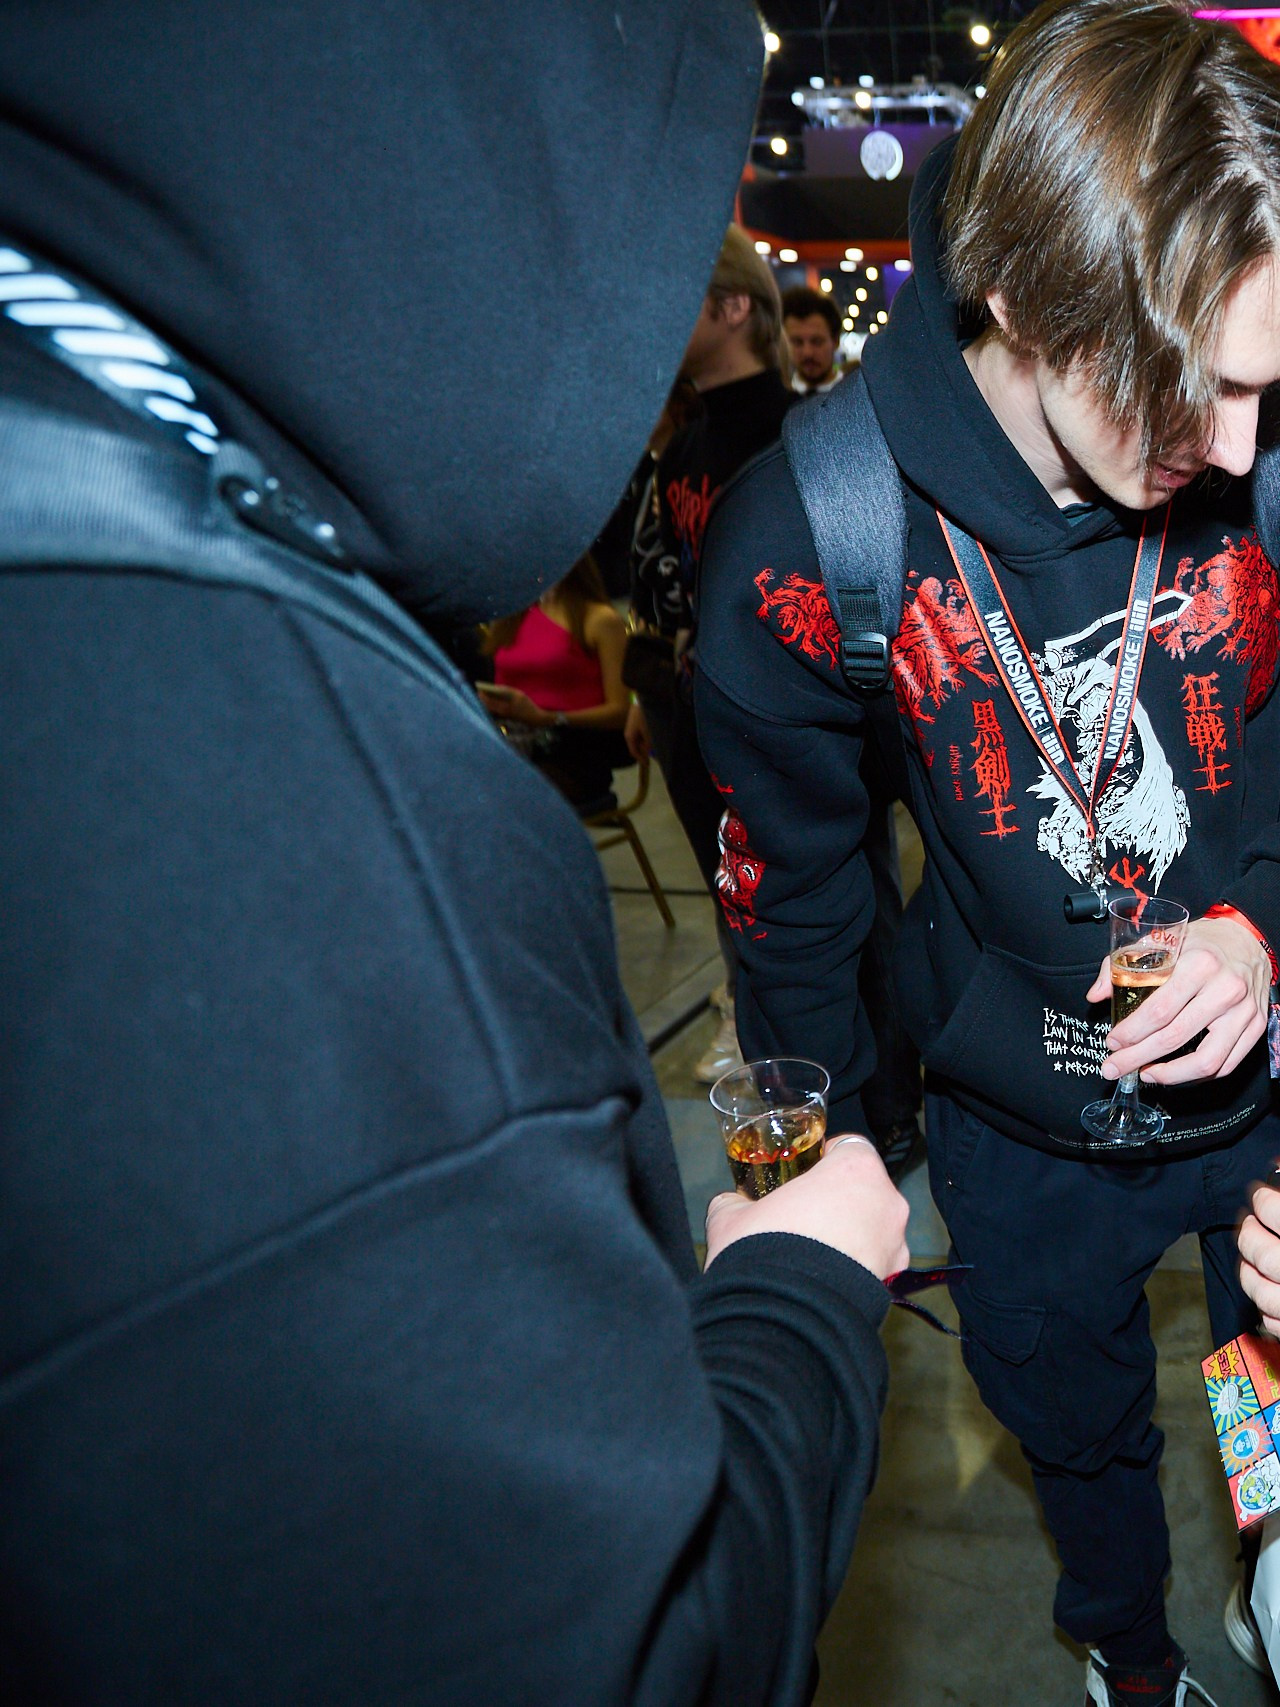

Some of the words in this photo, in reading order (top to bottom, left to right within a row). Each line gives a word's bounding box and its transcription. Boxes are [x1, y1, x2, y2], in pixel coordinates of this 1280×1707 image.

[984, 610, 1050, 729] NANOSMOKE
[1103, 640, 1141, 760] NANOSMOKE
[1042, 1022, 1068, 1041] LAW
[1199, 1121, 1226, 1131] GARMENT
[1218, 1353, 1232, 1379] YES
